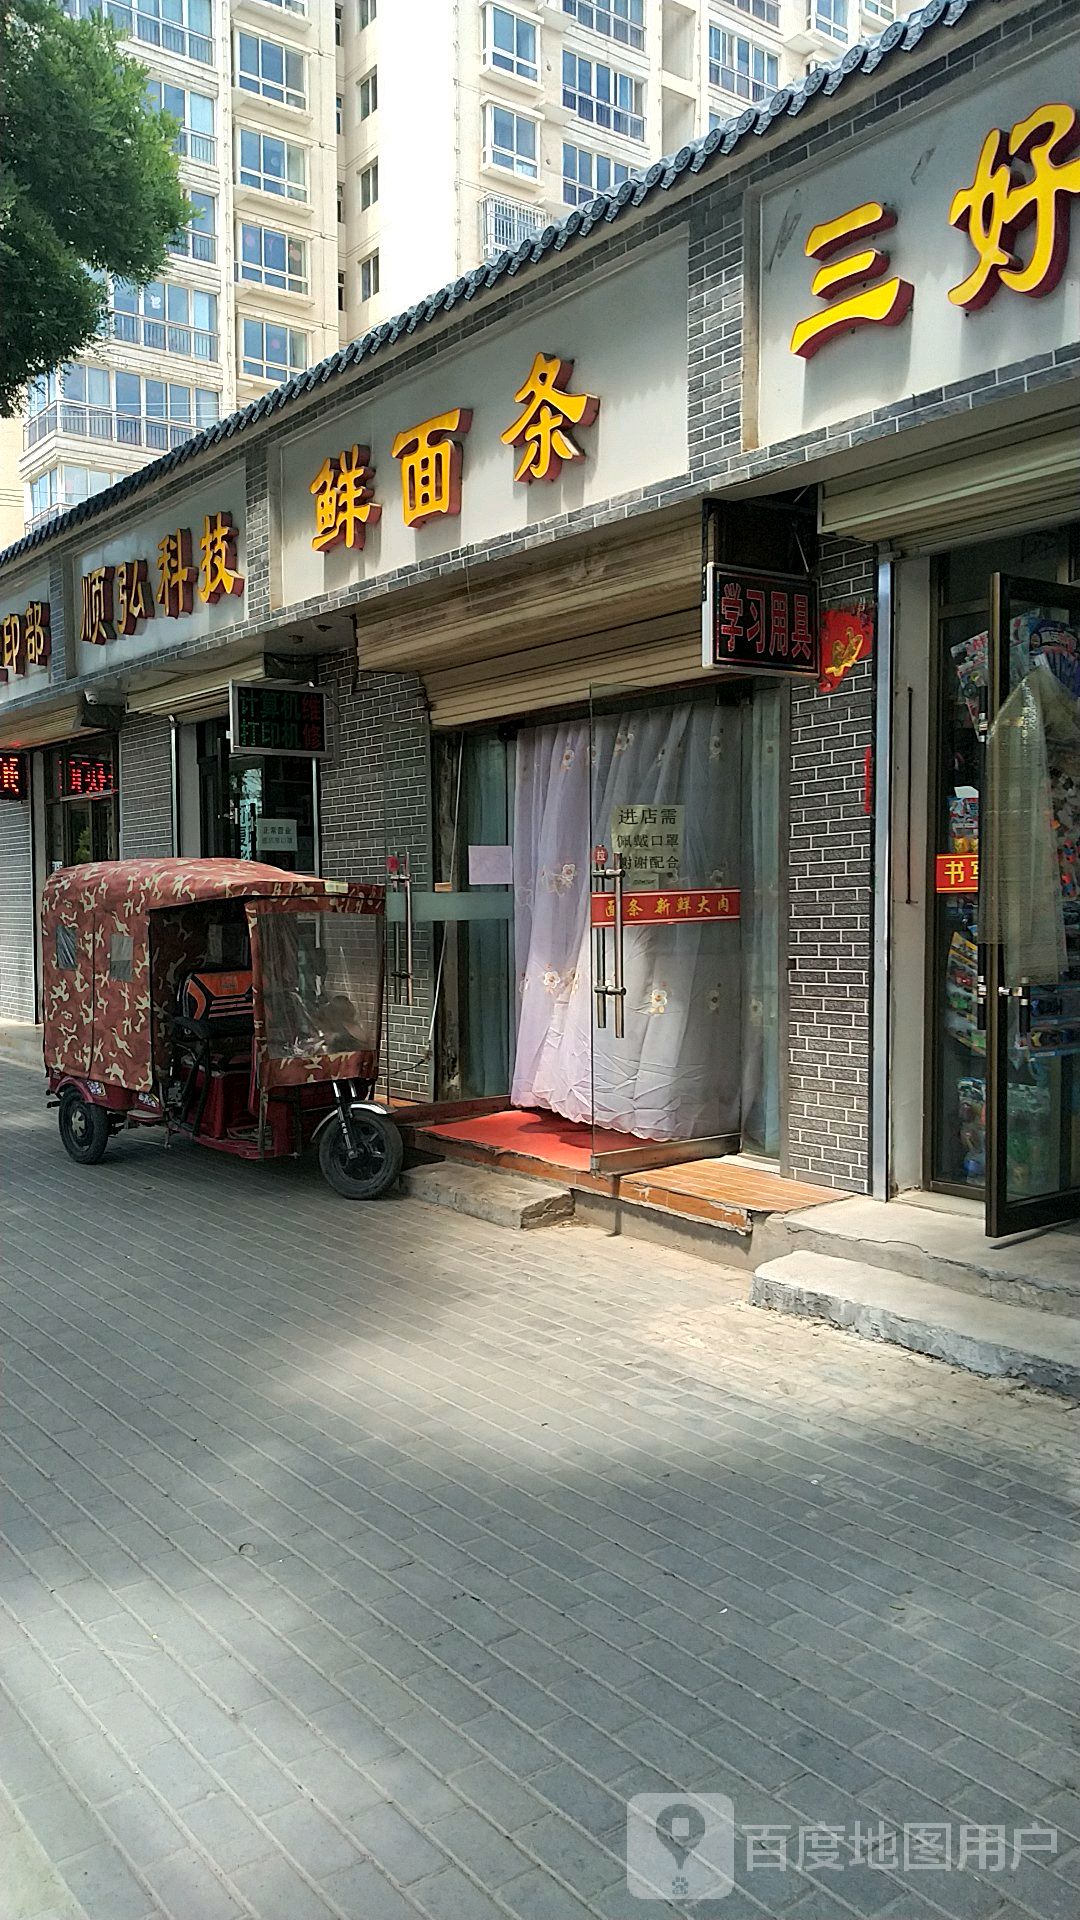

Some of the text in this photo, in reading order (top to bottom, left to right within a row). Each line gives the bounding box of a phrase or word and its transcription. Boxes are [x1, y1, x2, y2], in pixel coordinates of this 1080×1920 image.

[790, 103, 1080, 358] 三好
[310, 351, 600, 552] 鲜面条
[80, 511, 244, 645] 顺弘科技
[720, 582, 812, 660] 学习用具
[617, 833, 679, 849] 佩戴口罩
[618, 807, 677, 825] 进店需
